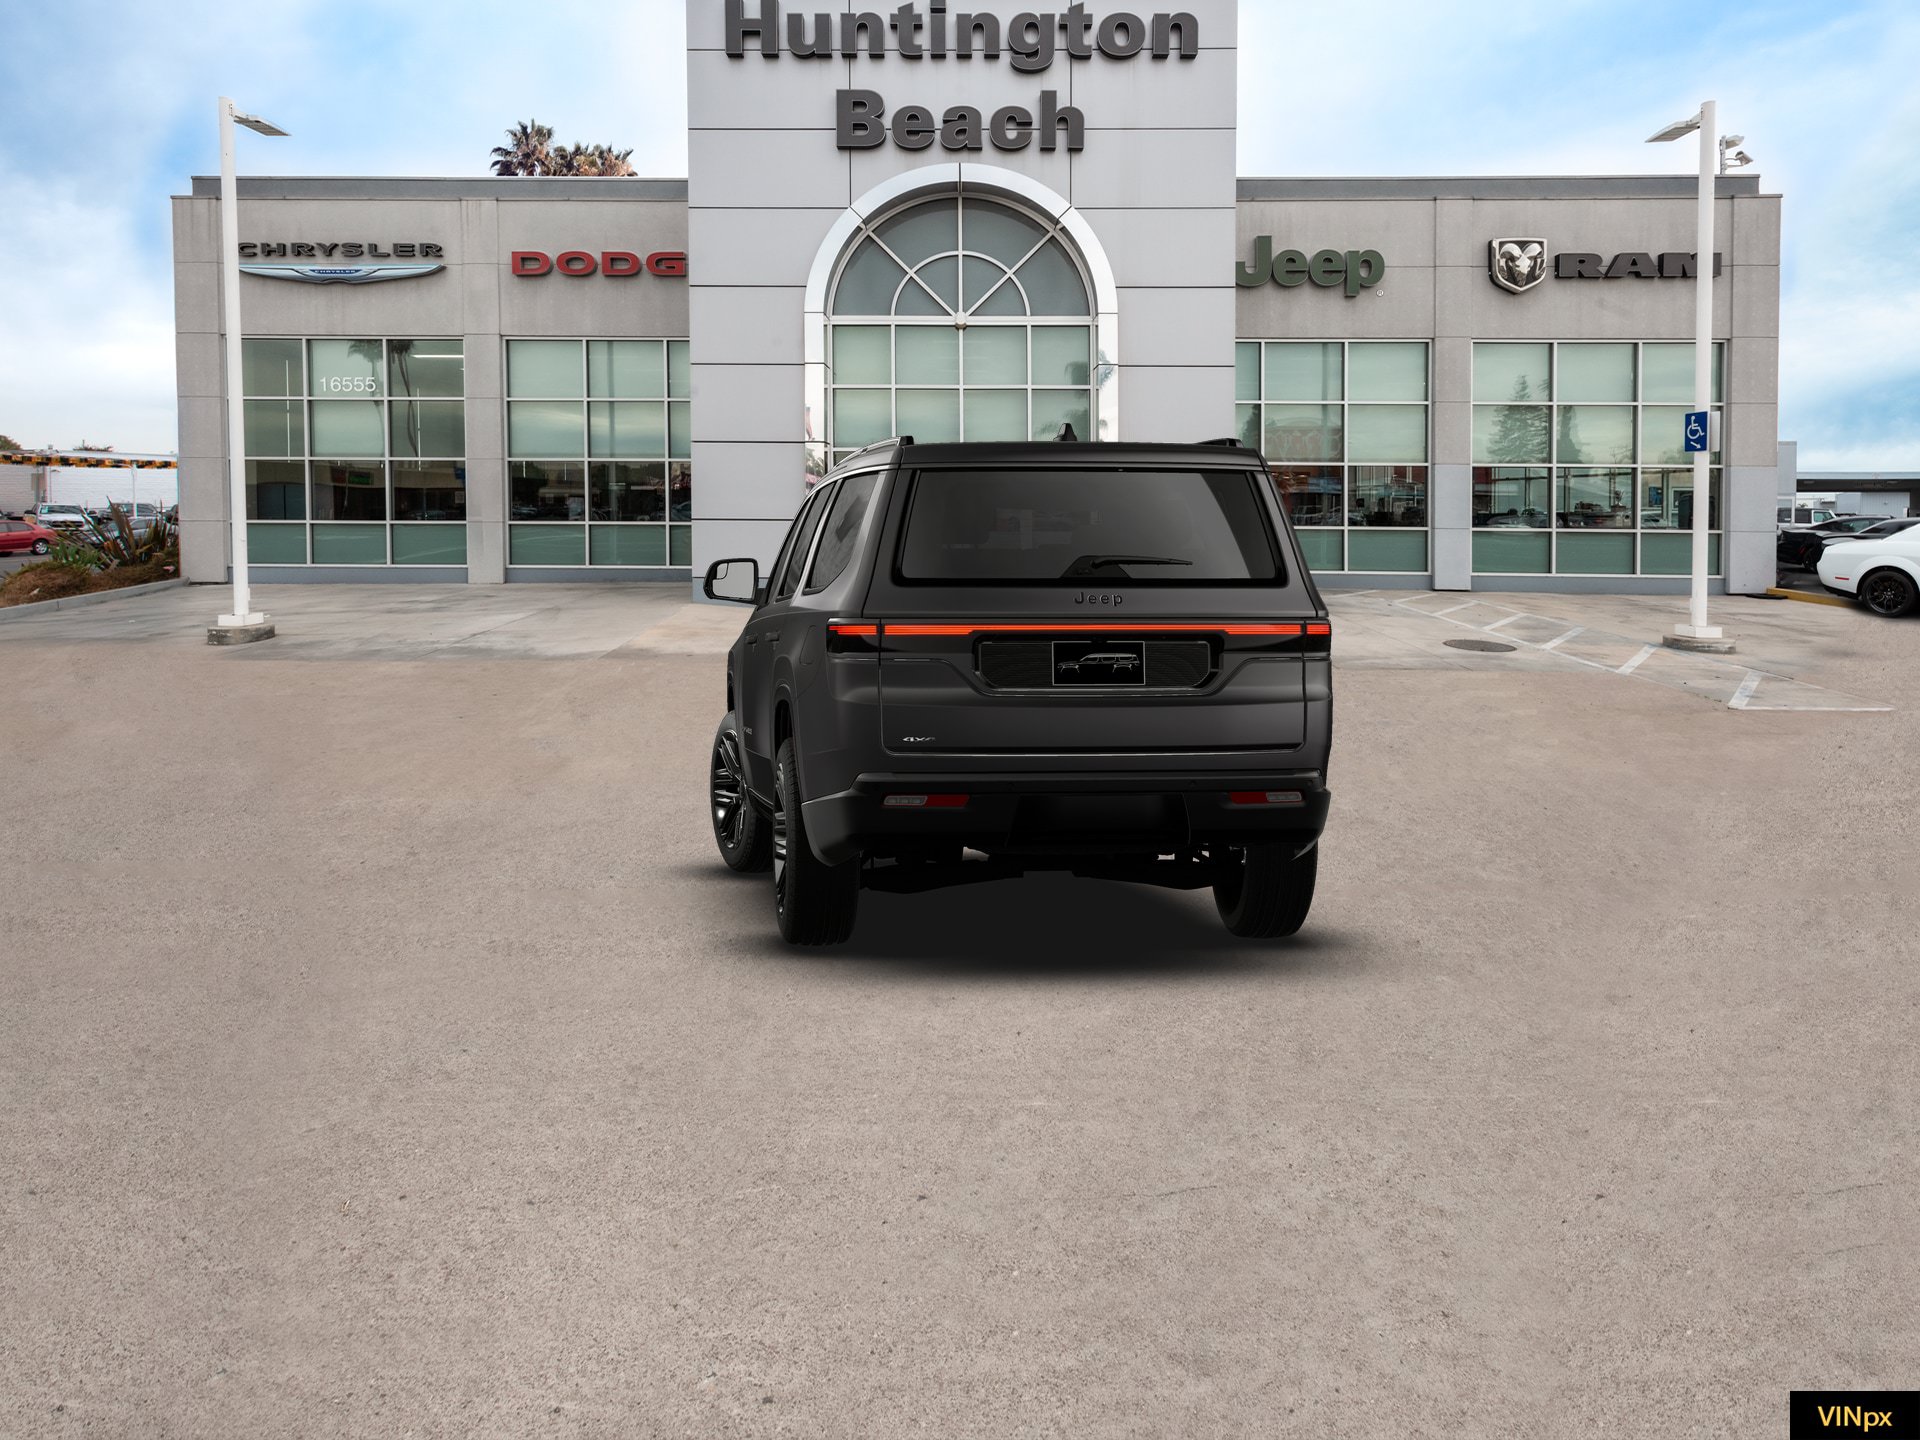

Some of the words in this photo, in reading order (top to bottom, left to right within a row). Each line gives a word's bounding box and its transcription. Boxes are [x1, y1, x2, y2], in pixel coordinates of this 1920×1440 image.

[724, 0, 1199, 74] Huntington
[836, 89, 1085, 152] Beach
[238, 242, 444, 258] CHRYSLER
[1235, 235, 1386, 297] Jeep
[1555, 252, 1722, 279] RAM
[319, 376, 377, 392] 16555
[1073, 591, 1123, 607] Jeep
